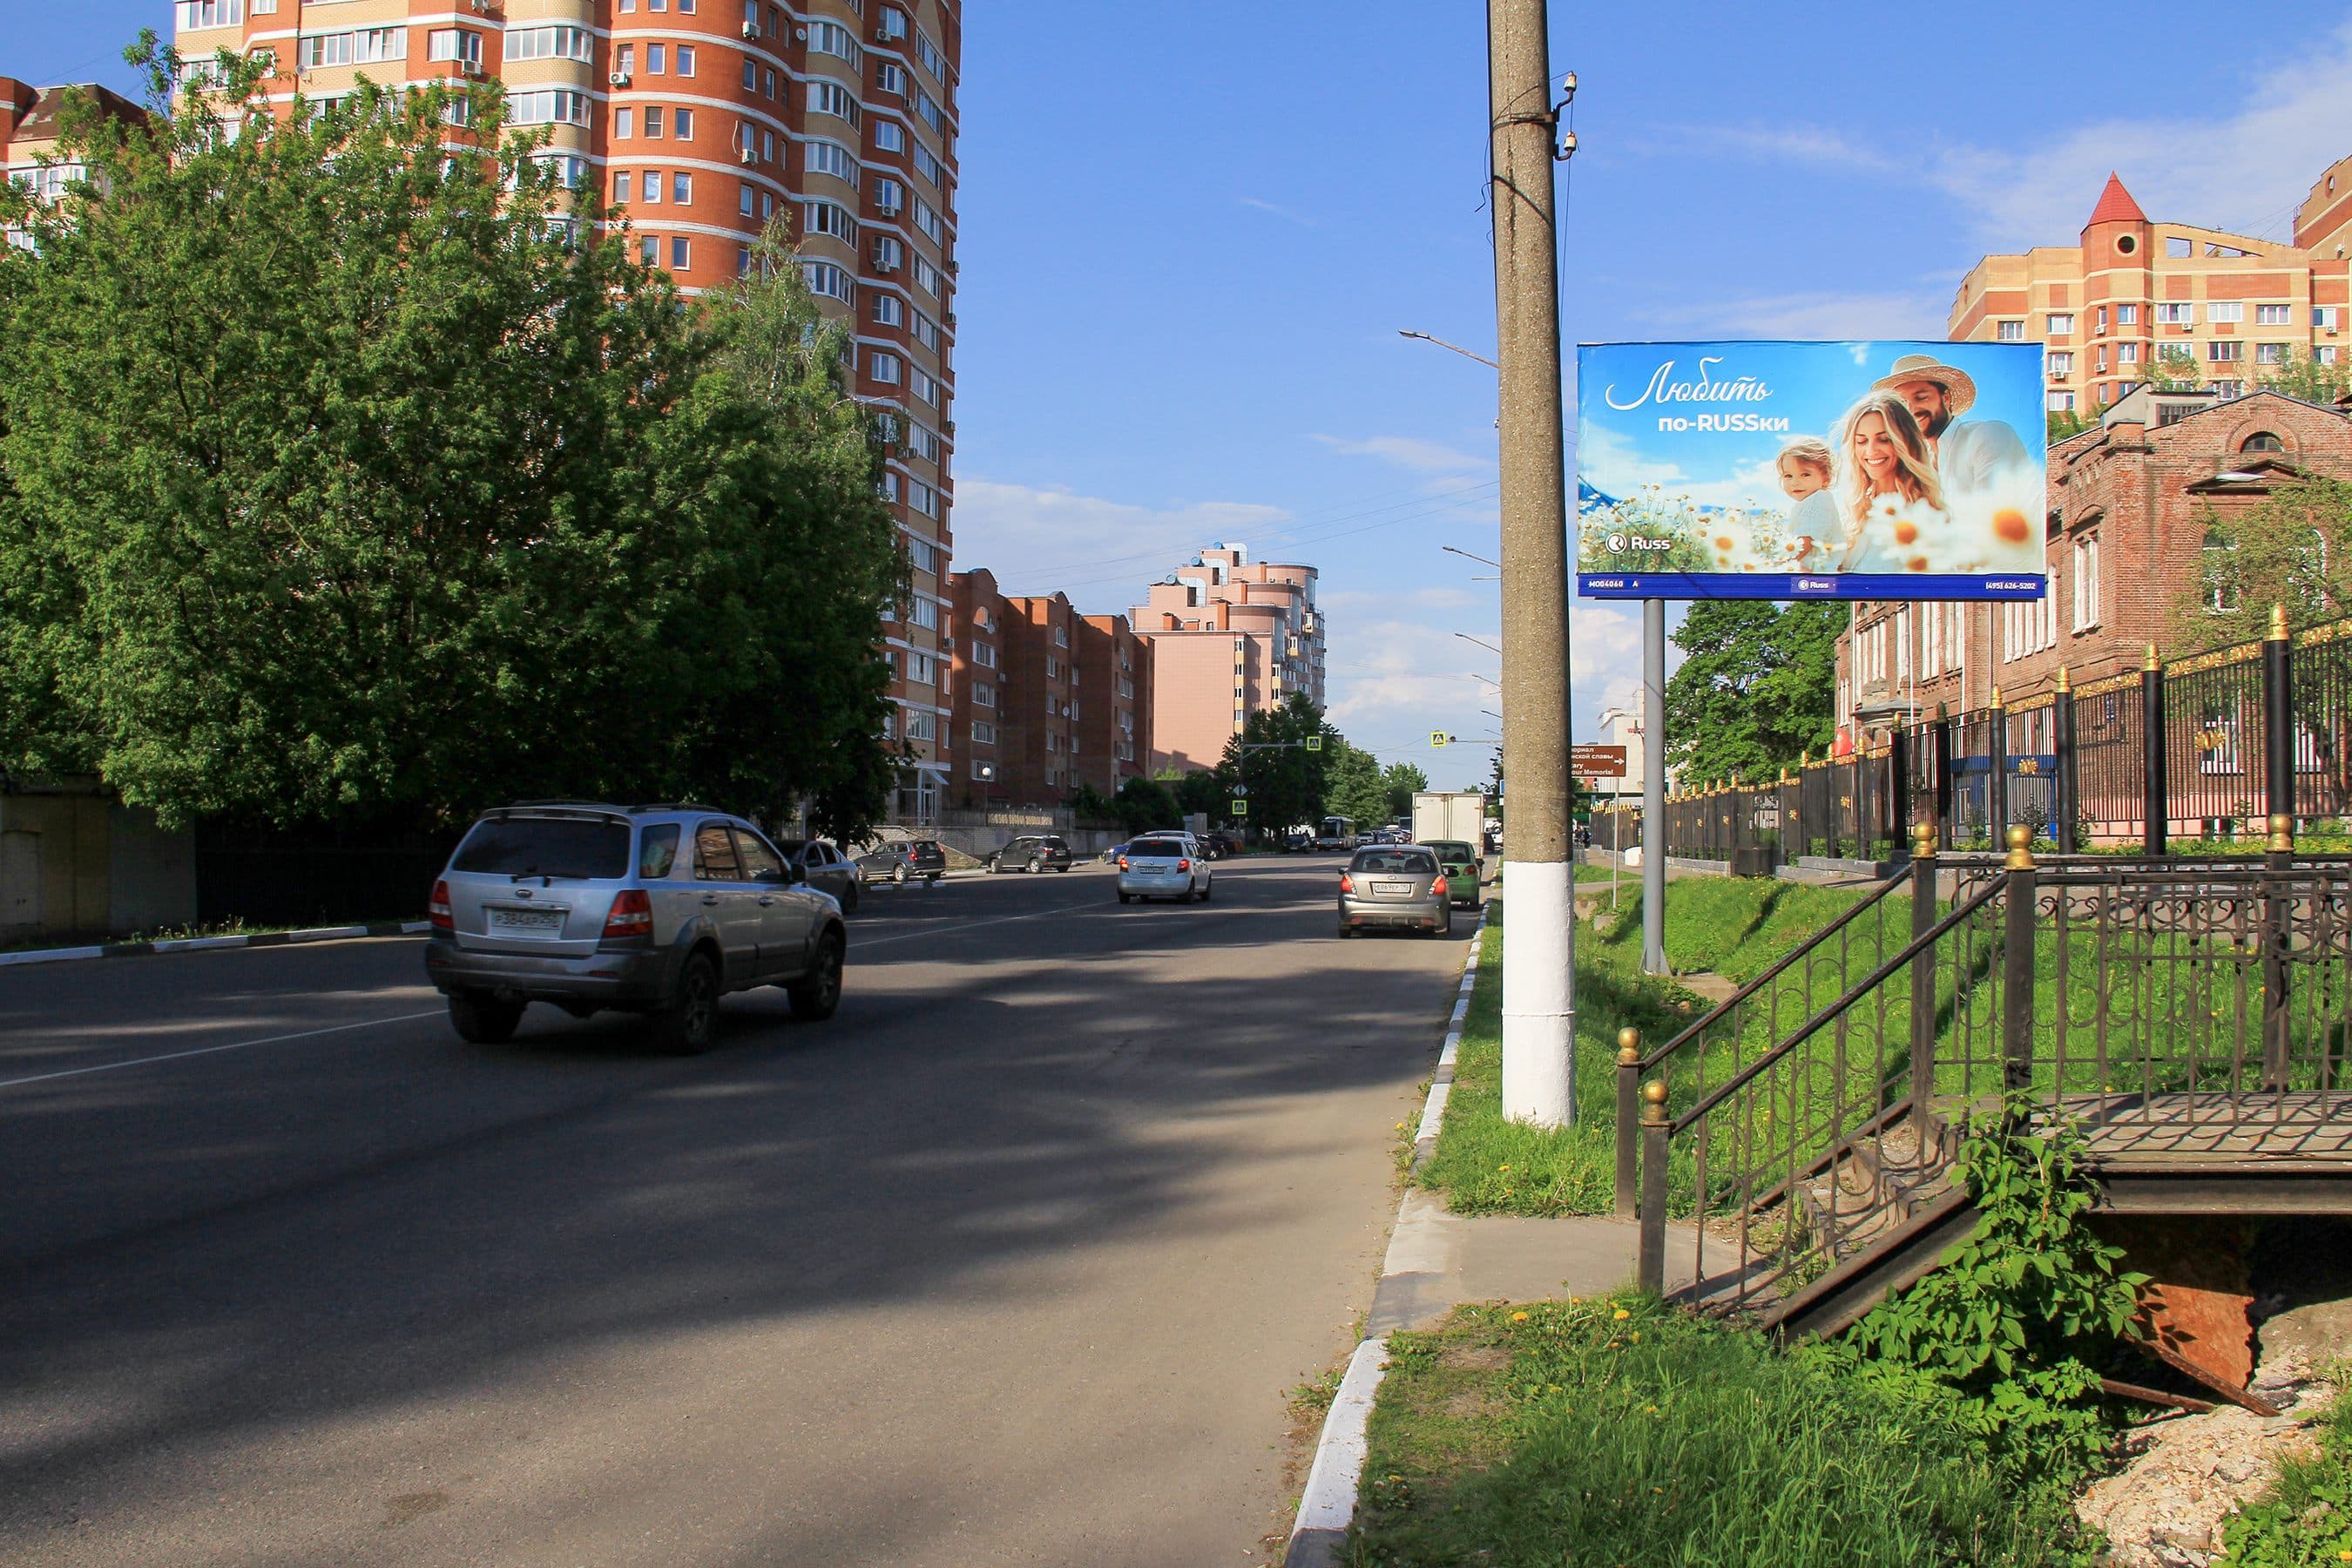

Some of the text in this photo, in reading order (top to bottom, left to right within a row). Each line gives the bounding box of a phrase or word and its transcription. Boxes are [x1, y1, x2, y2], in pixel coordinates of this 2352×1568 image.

[1605, 356, 1774, 411] Любить
[1658, 413, 1789, 432] по-RUSSки
[1631, 536, 1671, 551] Russ
[2004, 581, 2036, 590] 626-5202
